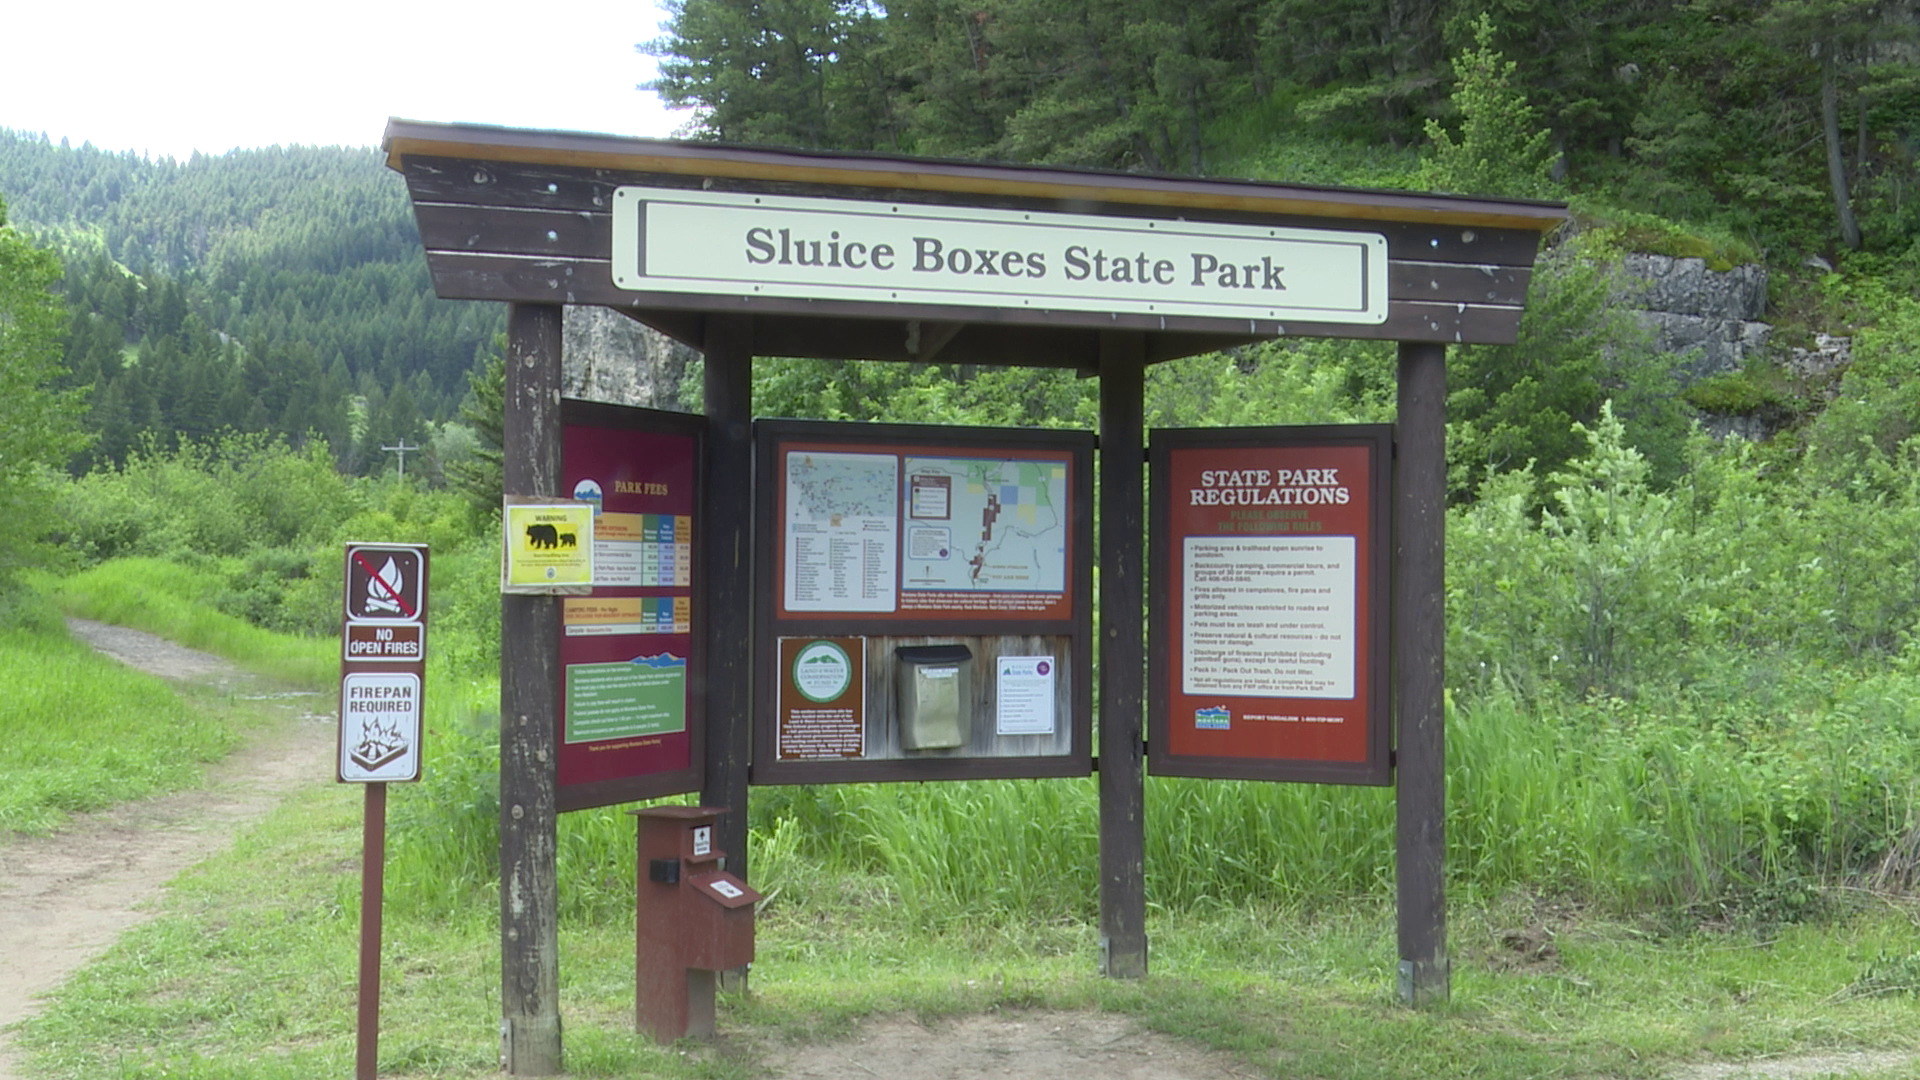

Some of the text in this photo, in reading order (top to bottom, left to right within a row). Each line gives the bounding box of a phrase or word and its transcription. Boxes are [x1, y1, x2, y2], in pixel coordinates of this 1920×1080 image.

[745, 226, 1287, 292] Sluice Boxes State Park
[1202, 469, 1338, 486] STATE PARK
[615, 480, 668, 495] PARK FEES
[1190, 488, 1349, 505] REGULATIONS
[1230, 510, 1308, 520] PLEASE OBSERVE
[1218, 522, 1322, 531] THE FOLLOWING RULES
[376, 628, 393, 641] NO
[350, 641, 418, 654] OPEN FIRES
[351, 686, 412, 699] FIREPAN
[350, 700, 412, 713] REQUIRED
